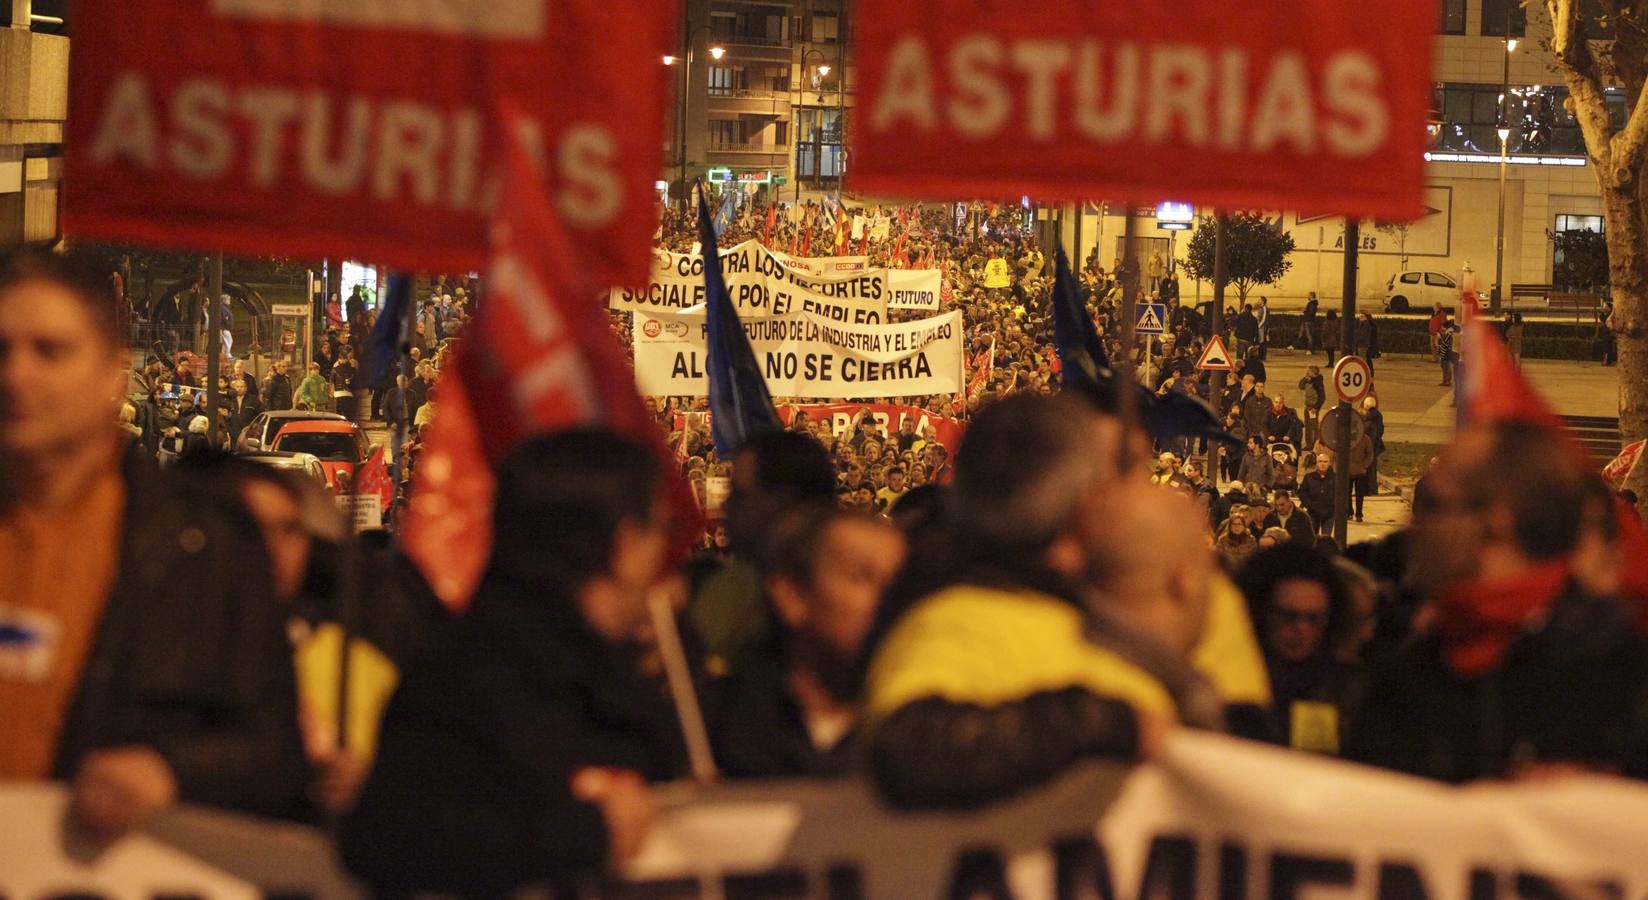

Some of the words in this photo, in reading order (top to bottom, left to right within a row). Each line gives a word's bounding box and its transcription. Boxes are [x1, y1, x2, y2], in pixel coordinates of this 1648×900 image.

[868, 34, 1392, 159] ASTURIAS
[677, 249, 750, 277] COTRA
[755, 248, 785, 281] LOS
[621, 282, 708, 308] SOCIALE
[895, 290, 934, 306] FUTURO
[789, 320, 803, 341] DE
[806, 321, 820, 342] LA
[822, 325, 881, 353] INDUSTRIA
[884, 334, 892, 353] Y
[895, 333, 908, 352] EL
[910, 322, 951, 350] EMPLEO
[765, 351, 798, 380] NO
[804, 352, 833, 381] SE
[841, 351, 932, 382] CIERRA
[1342, 372, 1363, 388] 30
